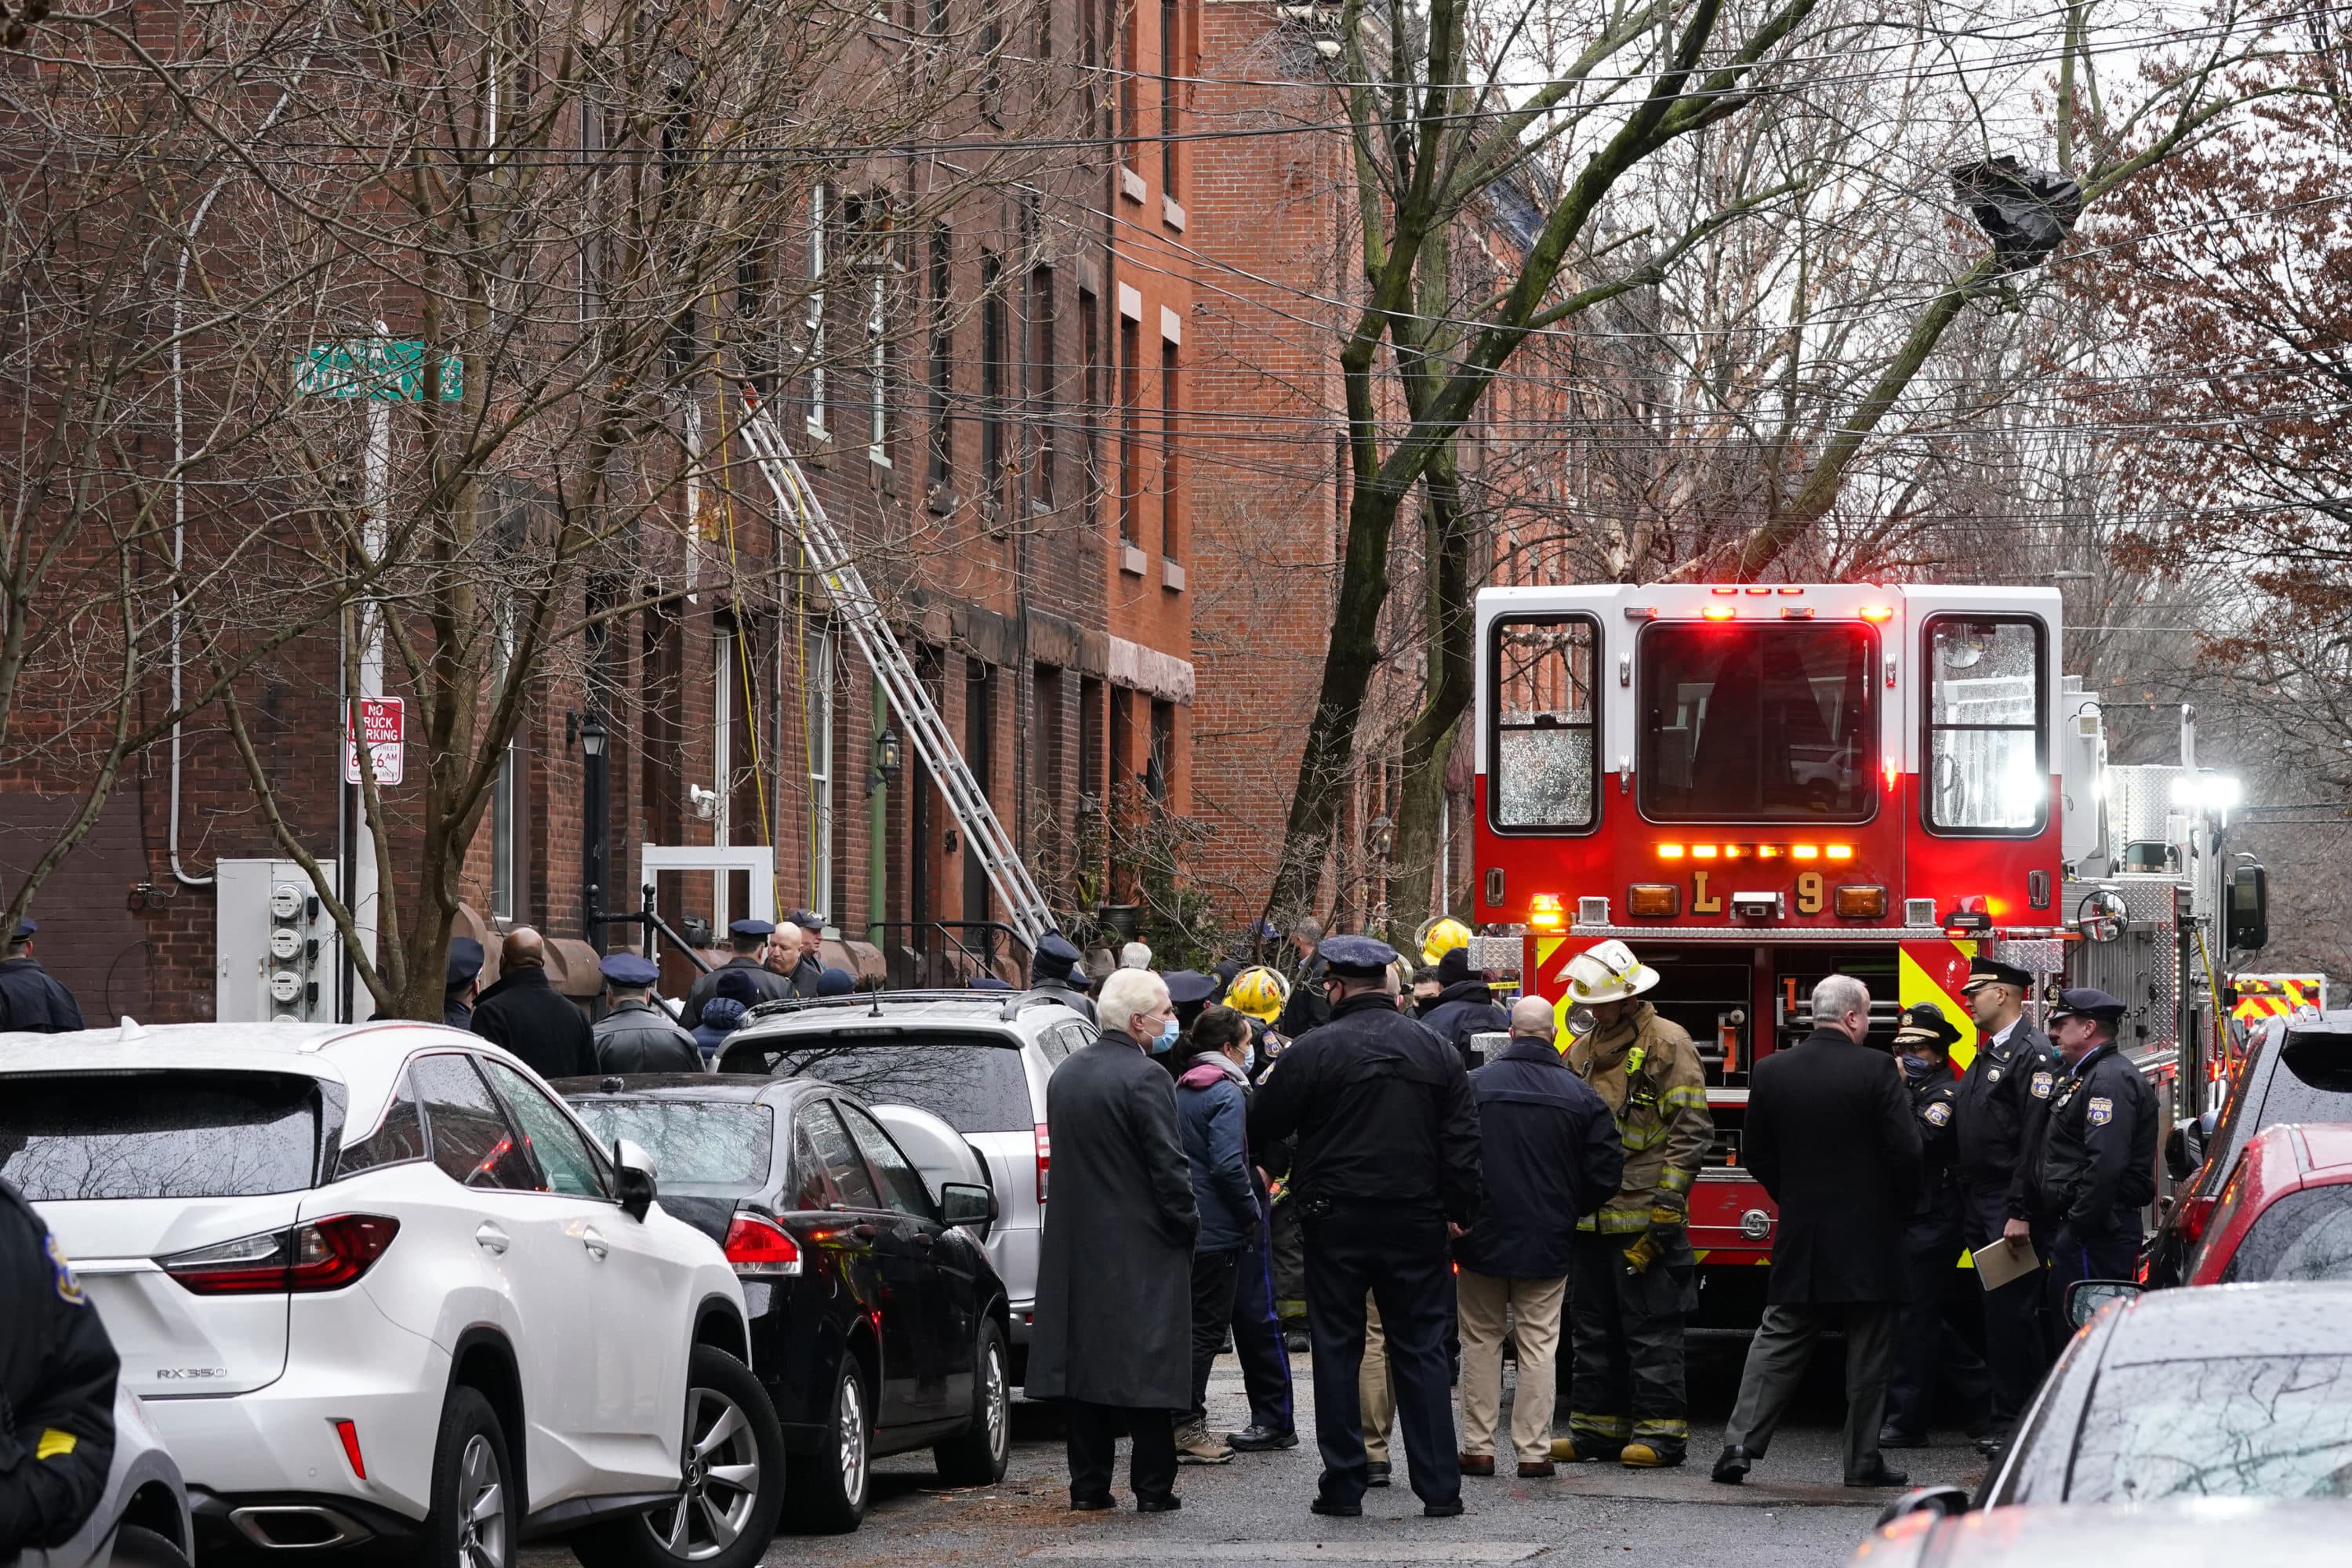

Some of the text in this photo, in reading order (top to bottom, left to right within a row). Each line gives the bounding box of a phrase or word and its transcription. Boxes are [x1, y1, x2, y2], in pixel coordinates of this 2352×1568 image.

[368, 705, 383, 716] NO
[362, 717, 393, 728] RUCK
[351, 728, 398, 741] RKING
[376, 753, 384, 768] 6
[1694, 871, 1824, 913] L 9
[157, 1367, 227, 1380] RX 350
